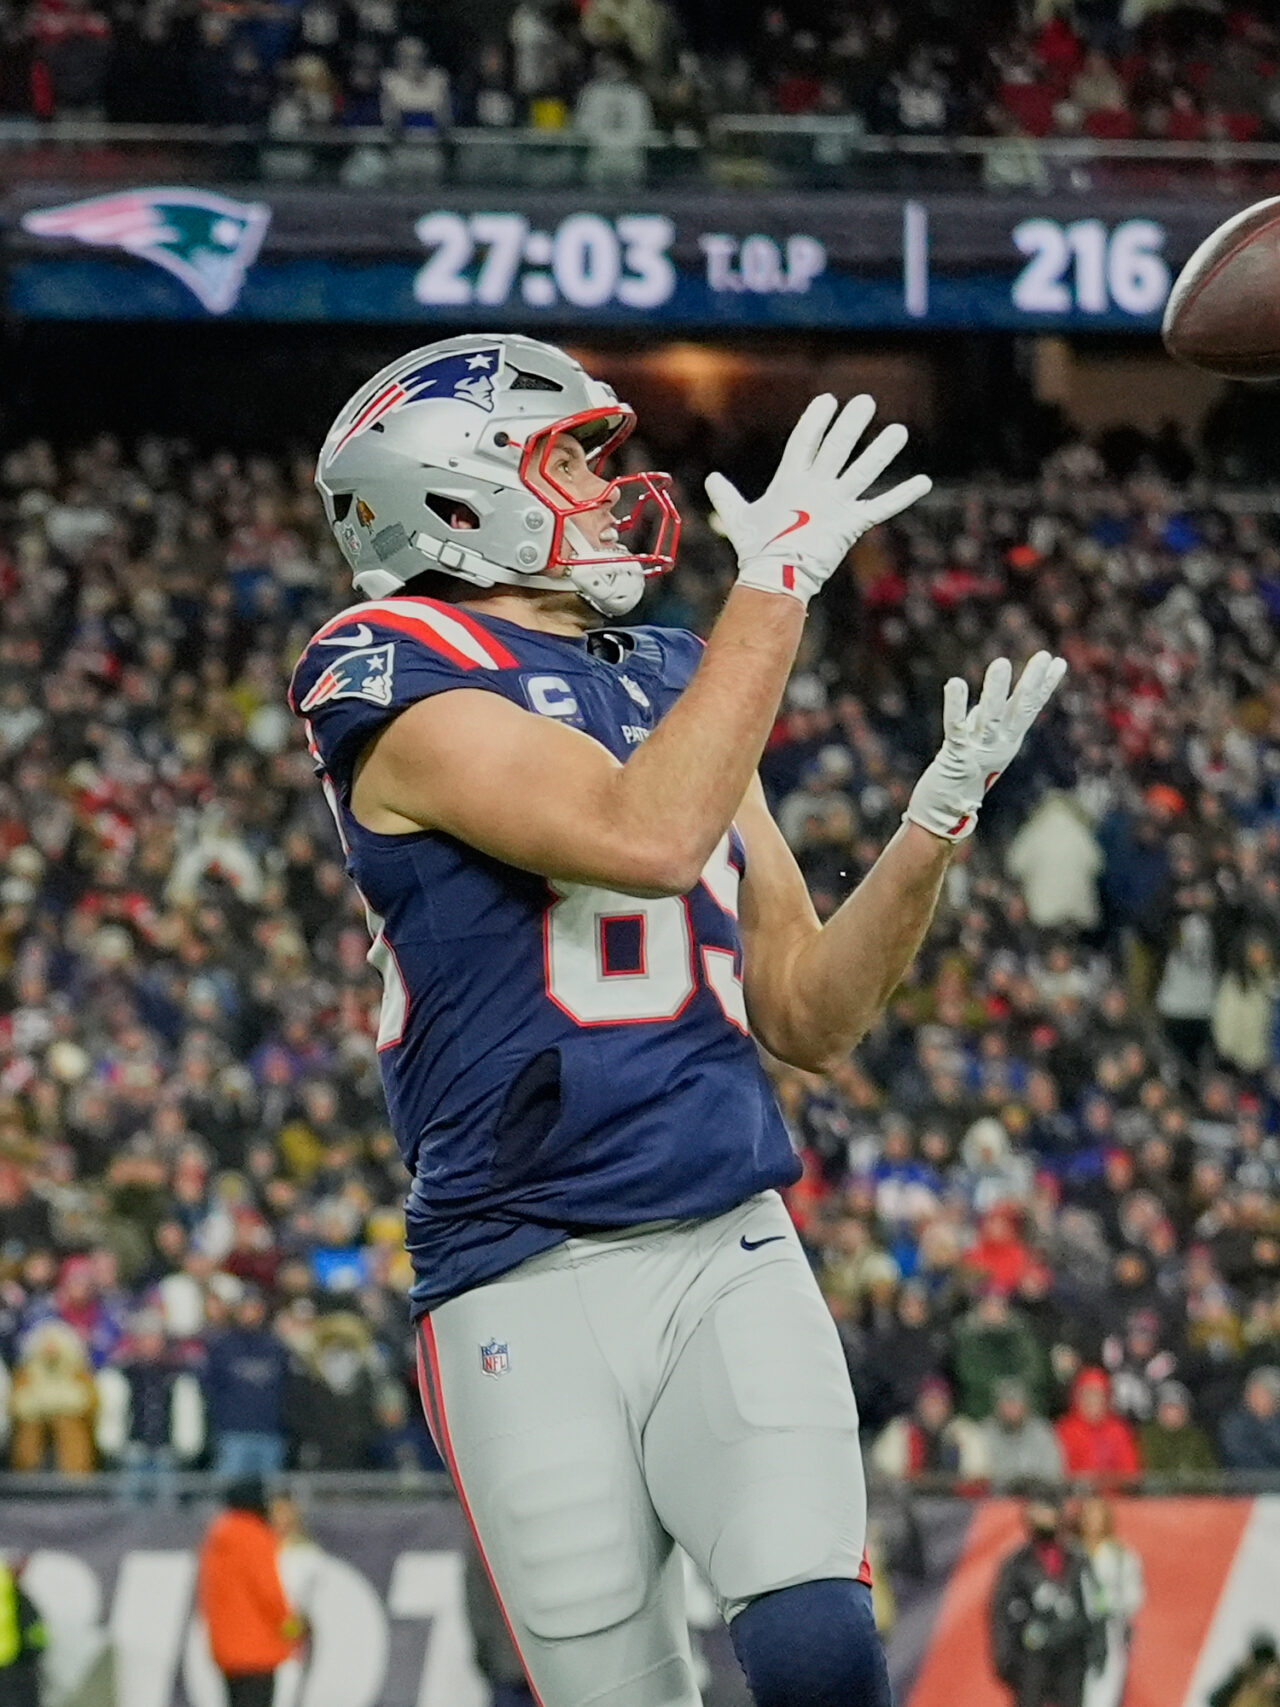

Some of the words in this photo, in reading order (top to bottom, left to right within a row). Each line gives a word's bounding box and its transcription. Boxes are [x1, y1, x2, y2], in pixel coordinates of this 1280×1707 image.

[413, 211, 676, 309] 27:03
[1012, 217, 1171, 315] 216
[527, 676, 578, 716] C
[484, 1355, 506, 1371] NFL
